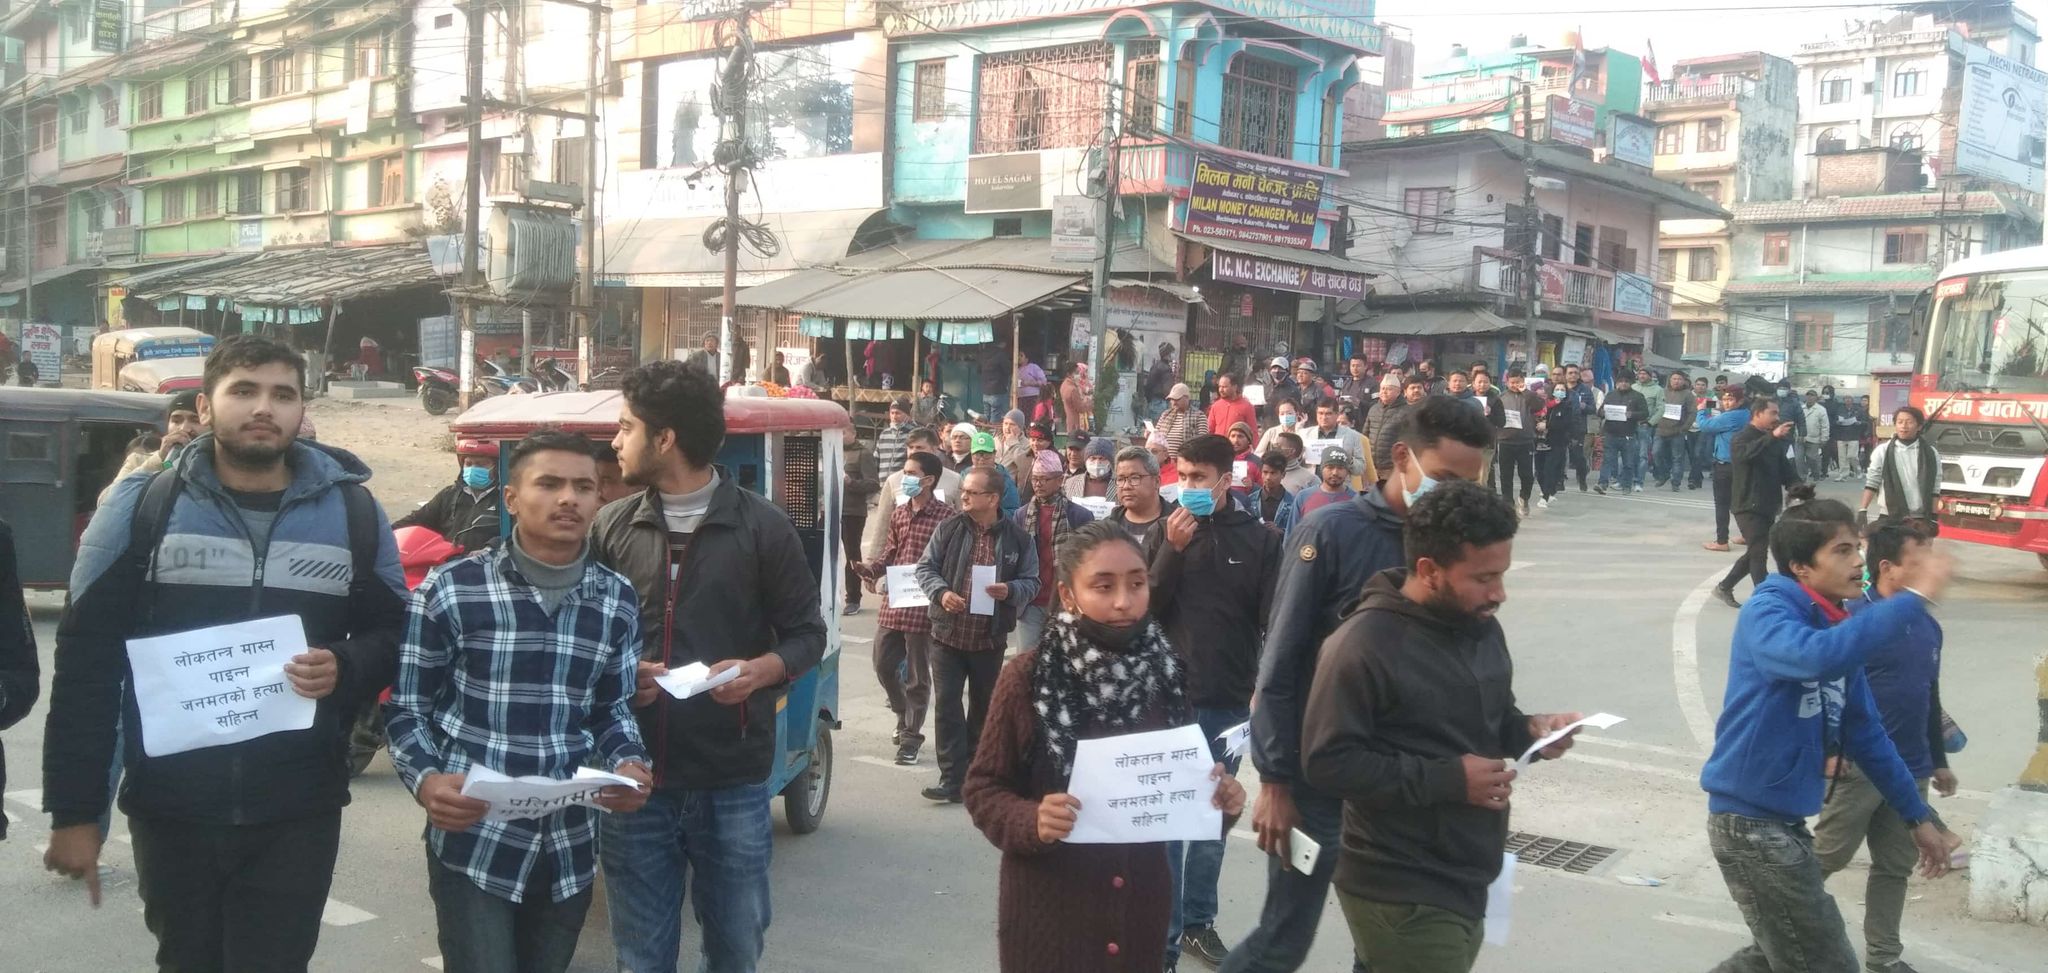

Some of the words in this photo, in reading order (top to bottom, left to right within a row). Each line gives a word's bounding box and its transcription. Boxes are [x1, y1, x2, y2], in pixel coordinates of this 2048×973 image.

[1988, 55, 2011, 72] MECHI
[1196, 163, 1230, 187] मिलन
[1191, 196, 1218, 212] MILAN
[1219, 200, 1247, 216] MONEY
[1248, 204, 1285, 221] CHANGER
[1286, 210, 1300, 223] Pvt.
[1301, 212, 1315, 225] Ltd.
[1254, 261, 1300, 285] EXCHANGE
[174, 646, 234, 668] लोकतन्त्र
[209, 666, 250, 683] पाइन्न
[180, 688, 245, 712] जनमतको
[252, 681, 284, 700] हत्या
[216, 708, 259, 728] सहिन्न
[1114, 753, 1165, 768] लोकतन्त्र
[1137, 771, 1173, 786] पाइन्न
[1107, 790, 1164, 810] जनमतको
[1169, 789, 1196, 805] हत्या
[1131, 811, 1168, 828] सहिन्न
